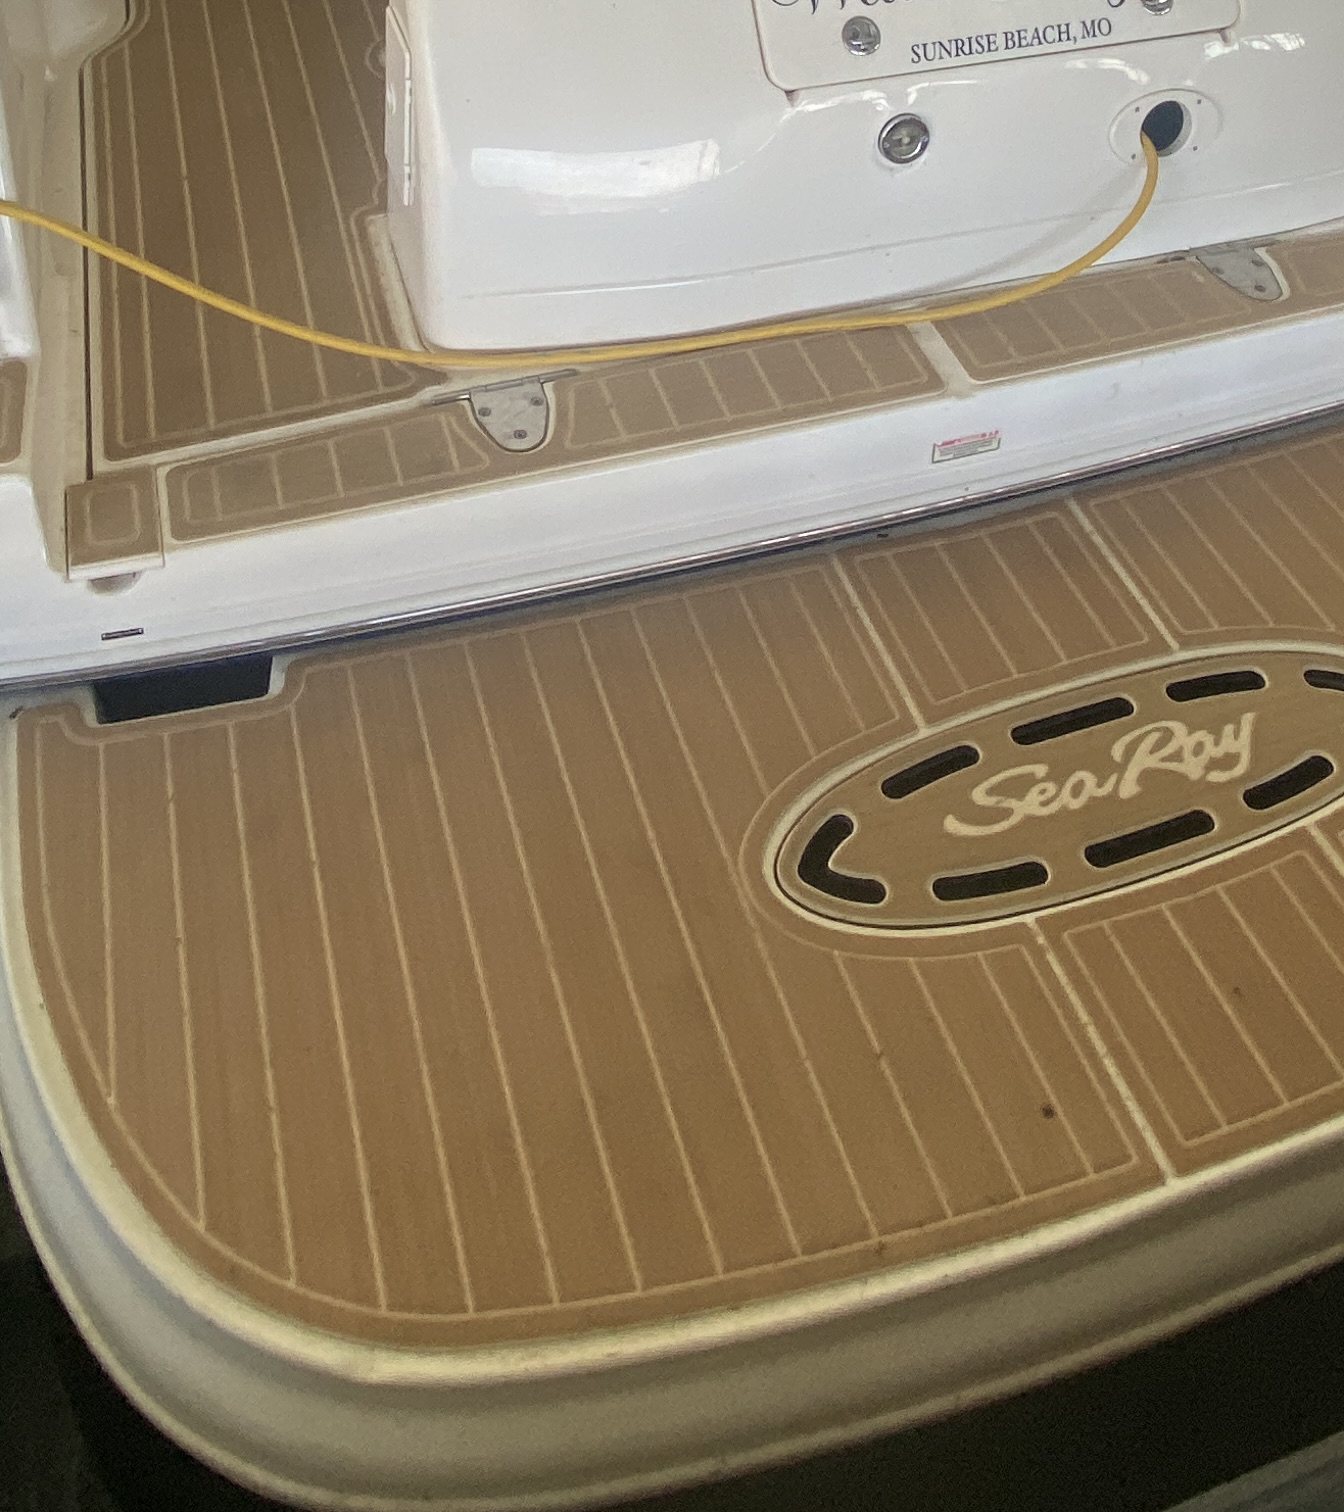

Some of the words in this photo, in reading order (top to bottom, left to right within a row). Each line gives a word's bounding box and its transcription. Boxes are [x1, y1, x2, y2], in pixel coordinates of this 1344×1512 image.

[911, 33, 999, 65] SUNRISE
[1003, 22, 1077, 51] BEACH,
[1080, 17, 1112, 40] MO
[943, 763, 1118, 836] Sea
[1111, 712, 1256, 799] Ray
